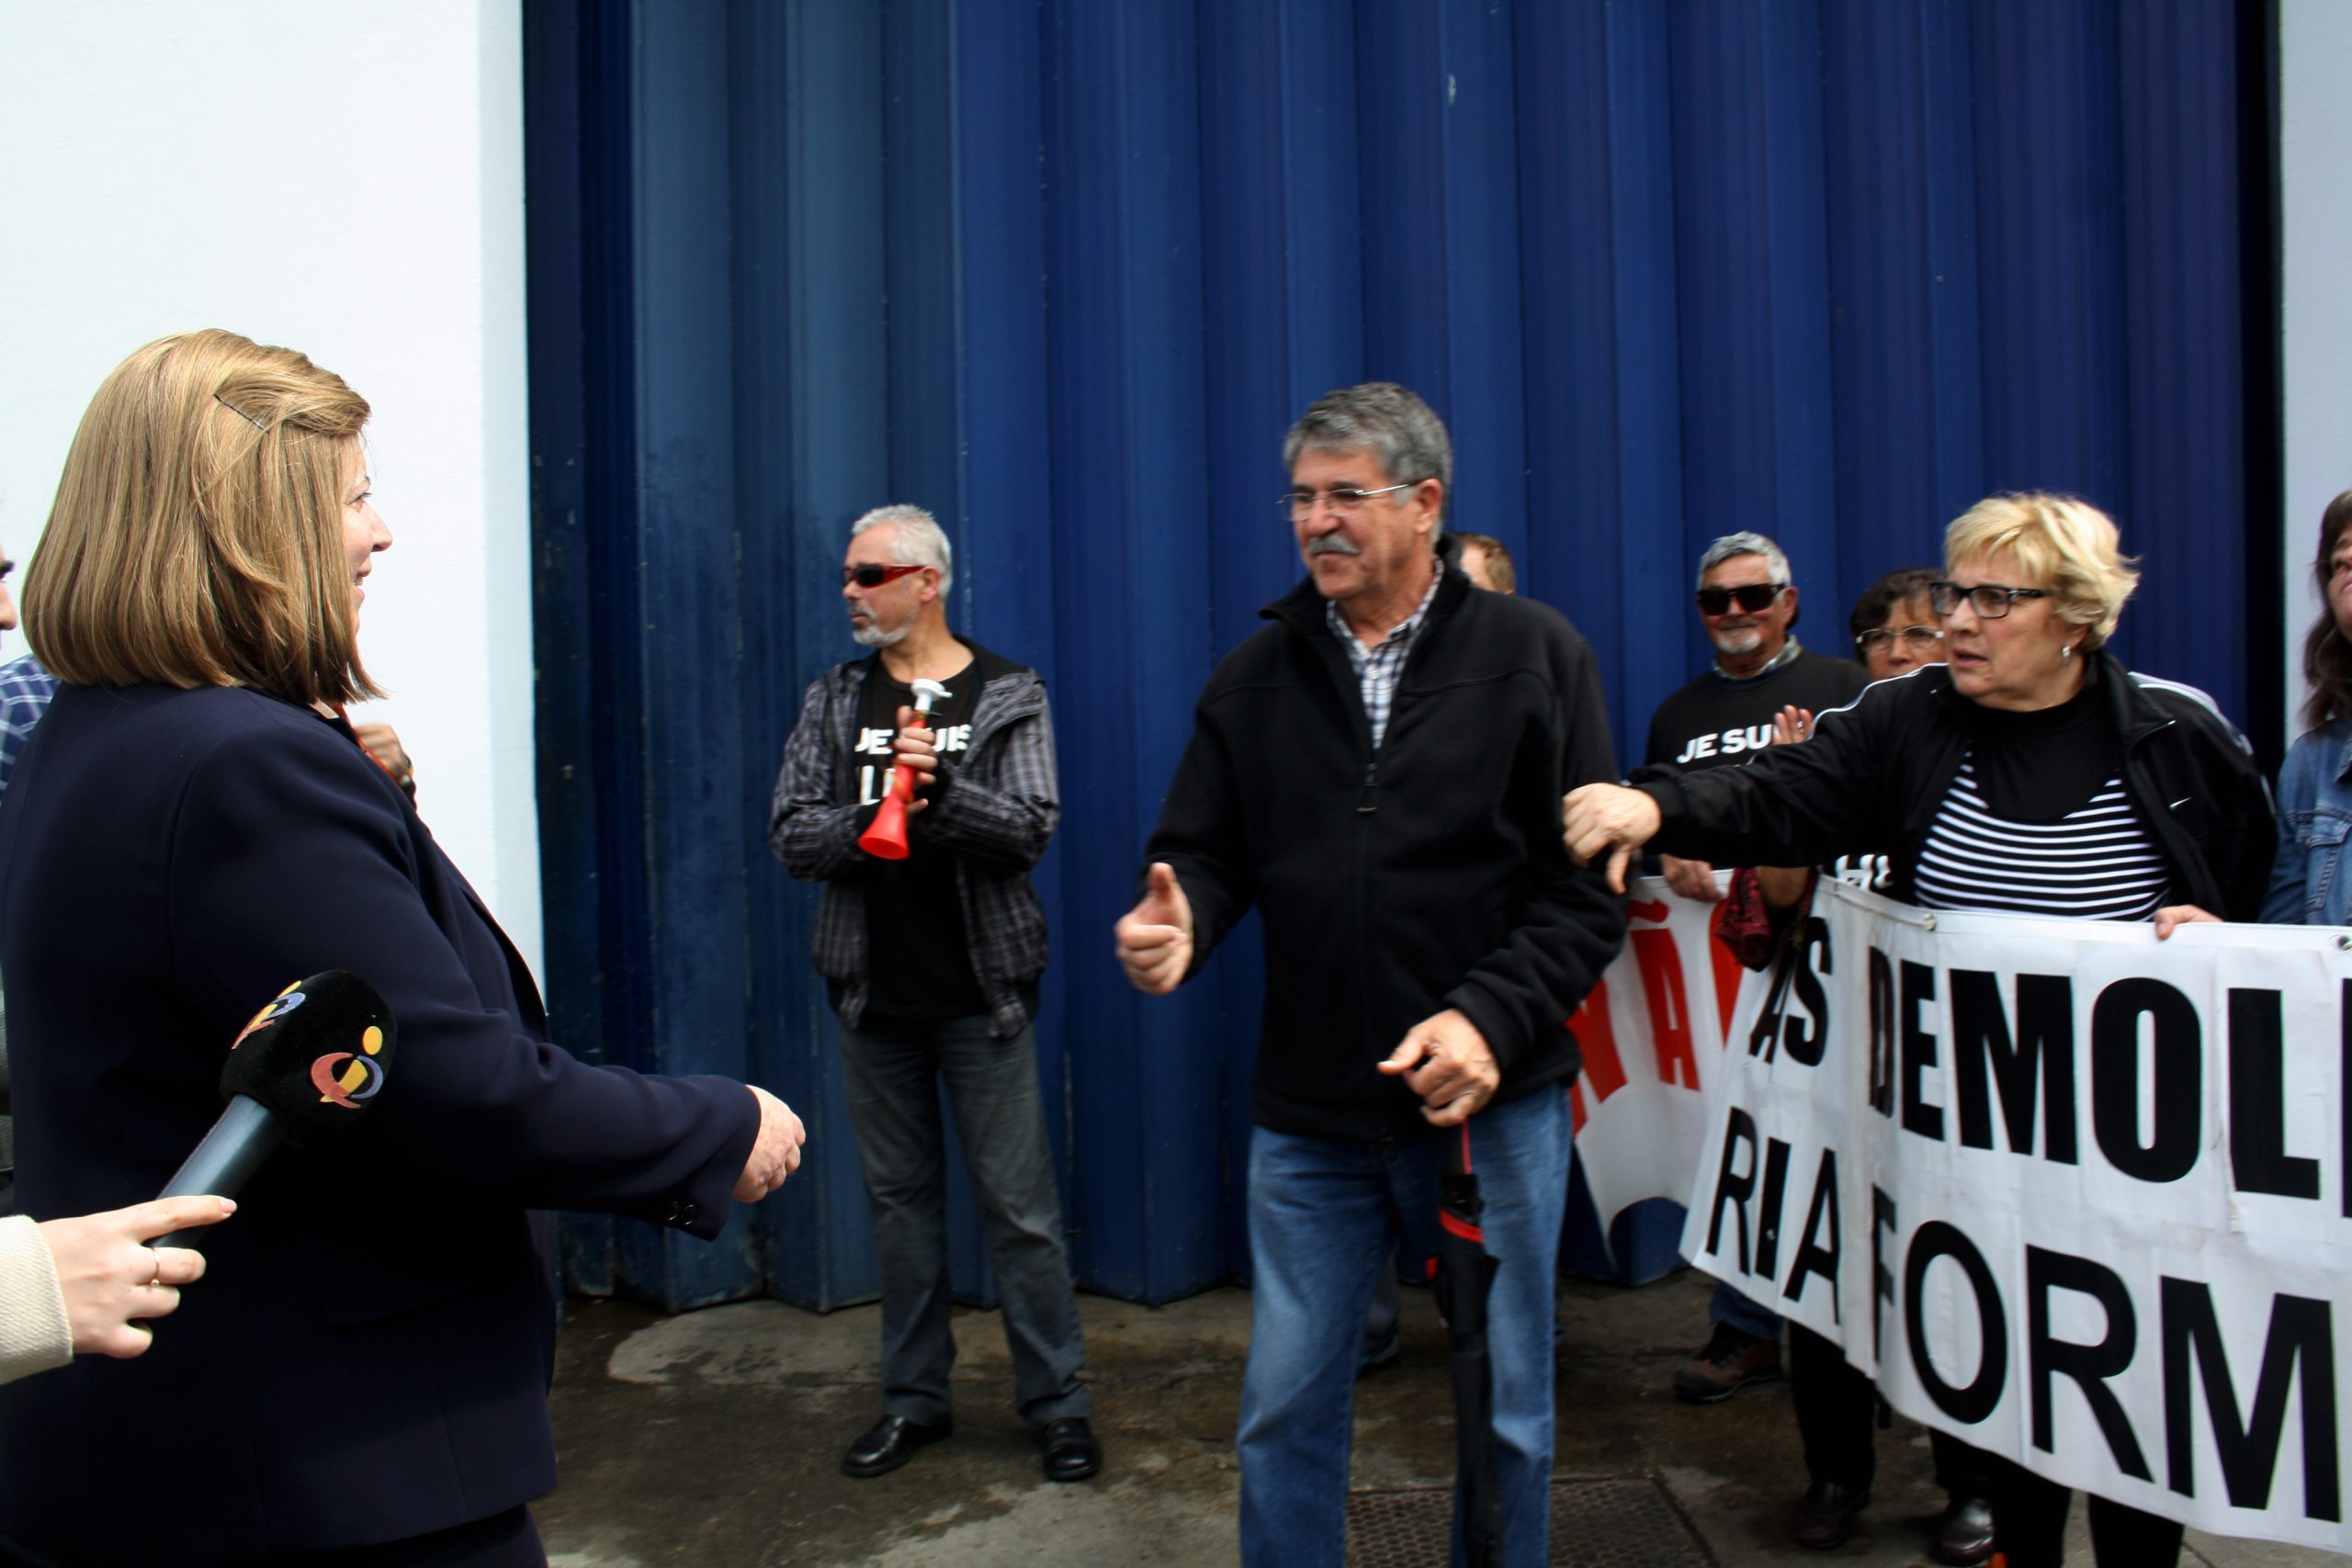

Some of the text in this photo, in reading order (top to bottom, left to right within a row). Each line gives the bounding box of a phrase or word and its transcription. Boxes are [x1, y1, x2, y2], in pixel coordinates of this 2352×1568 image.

[854, 728, 894, 754] JE
[1675, 733, 1719, 764] JE
[1869, 945, 2352, 1219] DEMOL
[1707, 1106, 2342, 1523] RIA FORM
